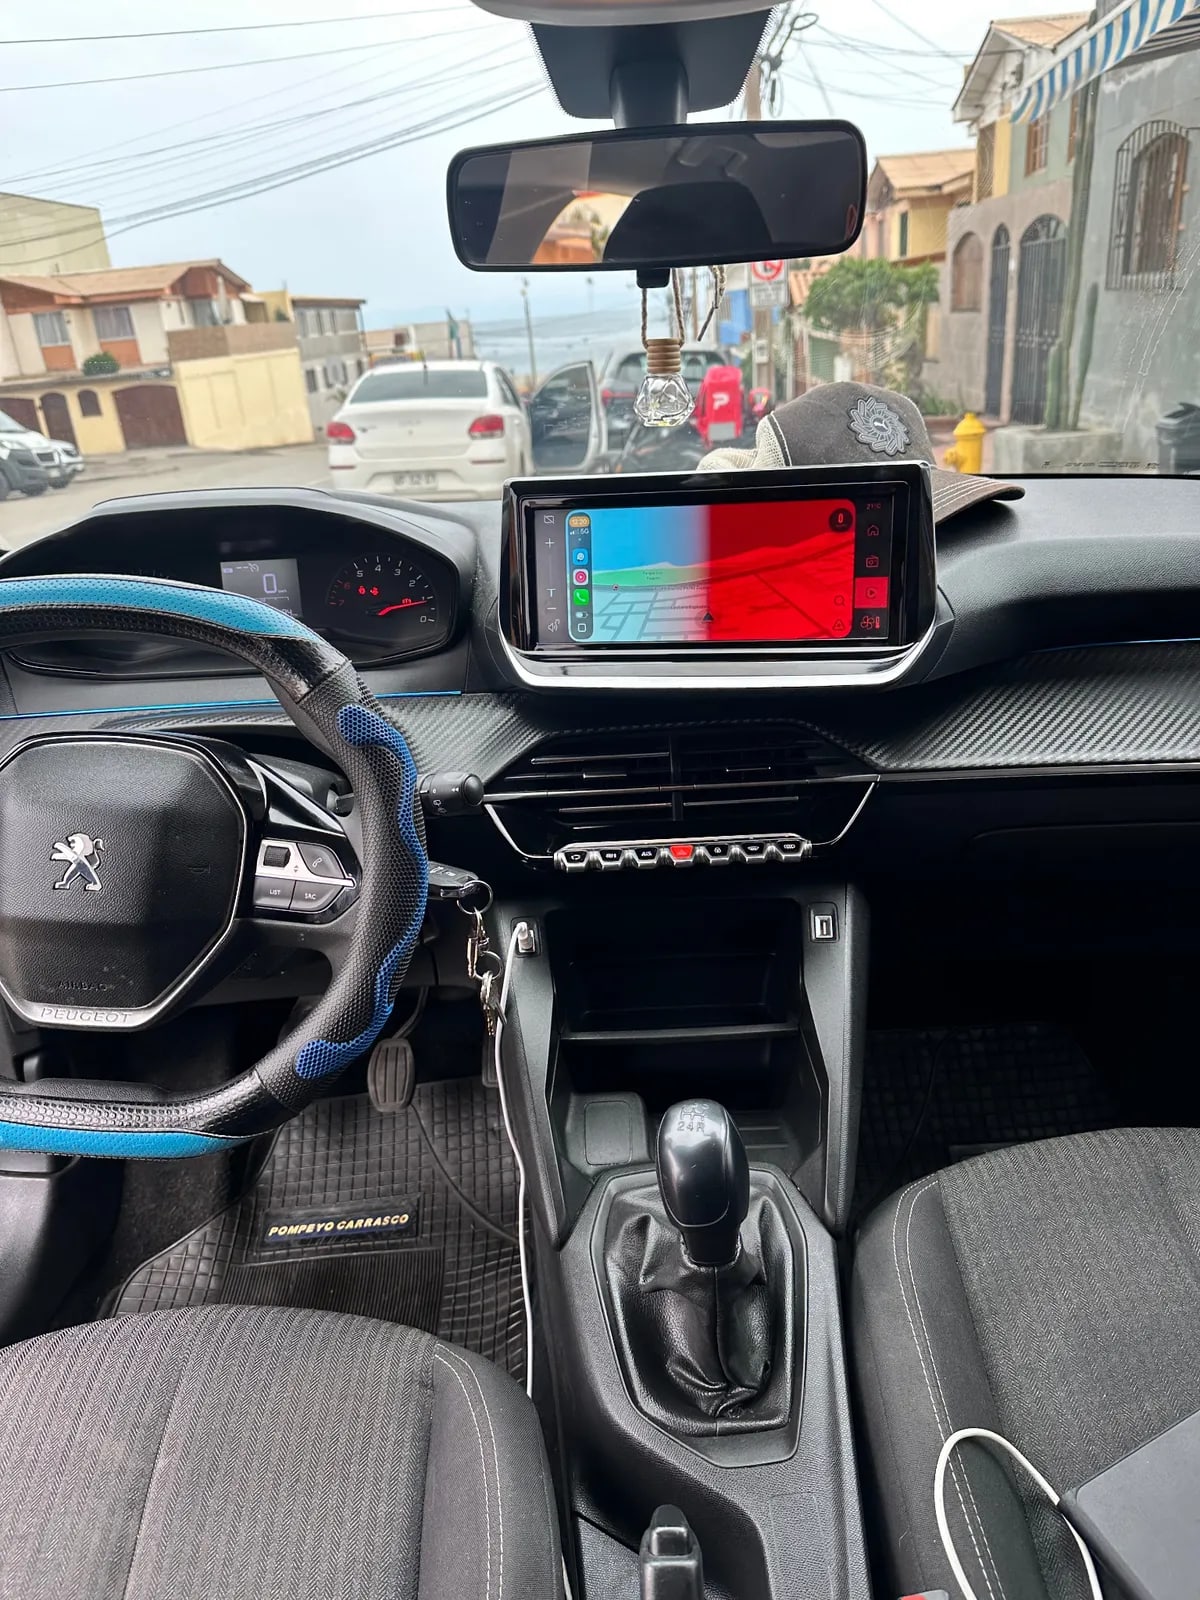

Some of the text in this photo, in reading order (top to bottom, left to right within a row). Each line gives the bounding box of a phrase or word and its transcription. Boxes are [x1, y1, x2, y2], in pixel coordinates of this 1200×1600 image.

[712, 392, 730, 410] P
[375, 564, 381, 572] 4
[263, 573, 277, 594] 0
[40, 1007, 132, 1023] PEUGEOT
[268, 1213, 409, 1237] POMPEYO CARRASCO
